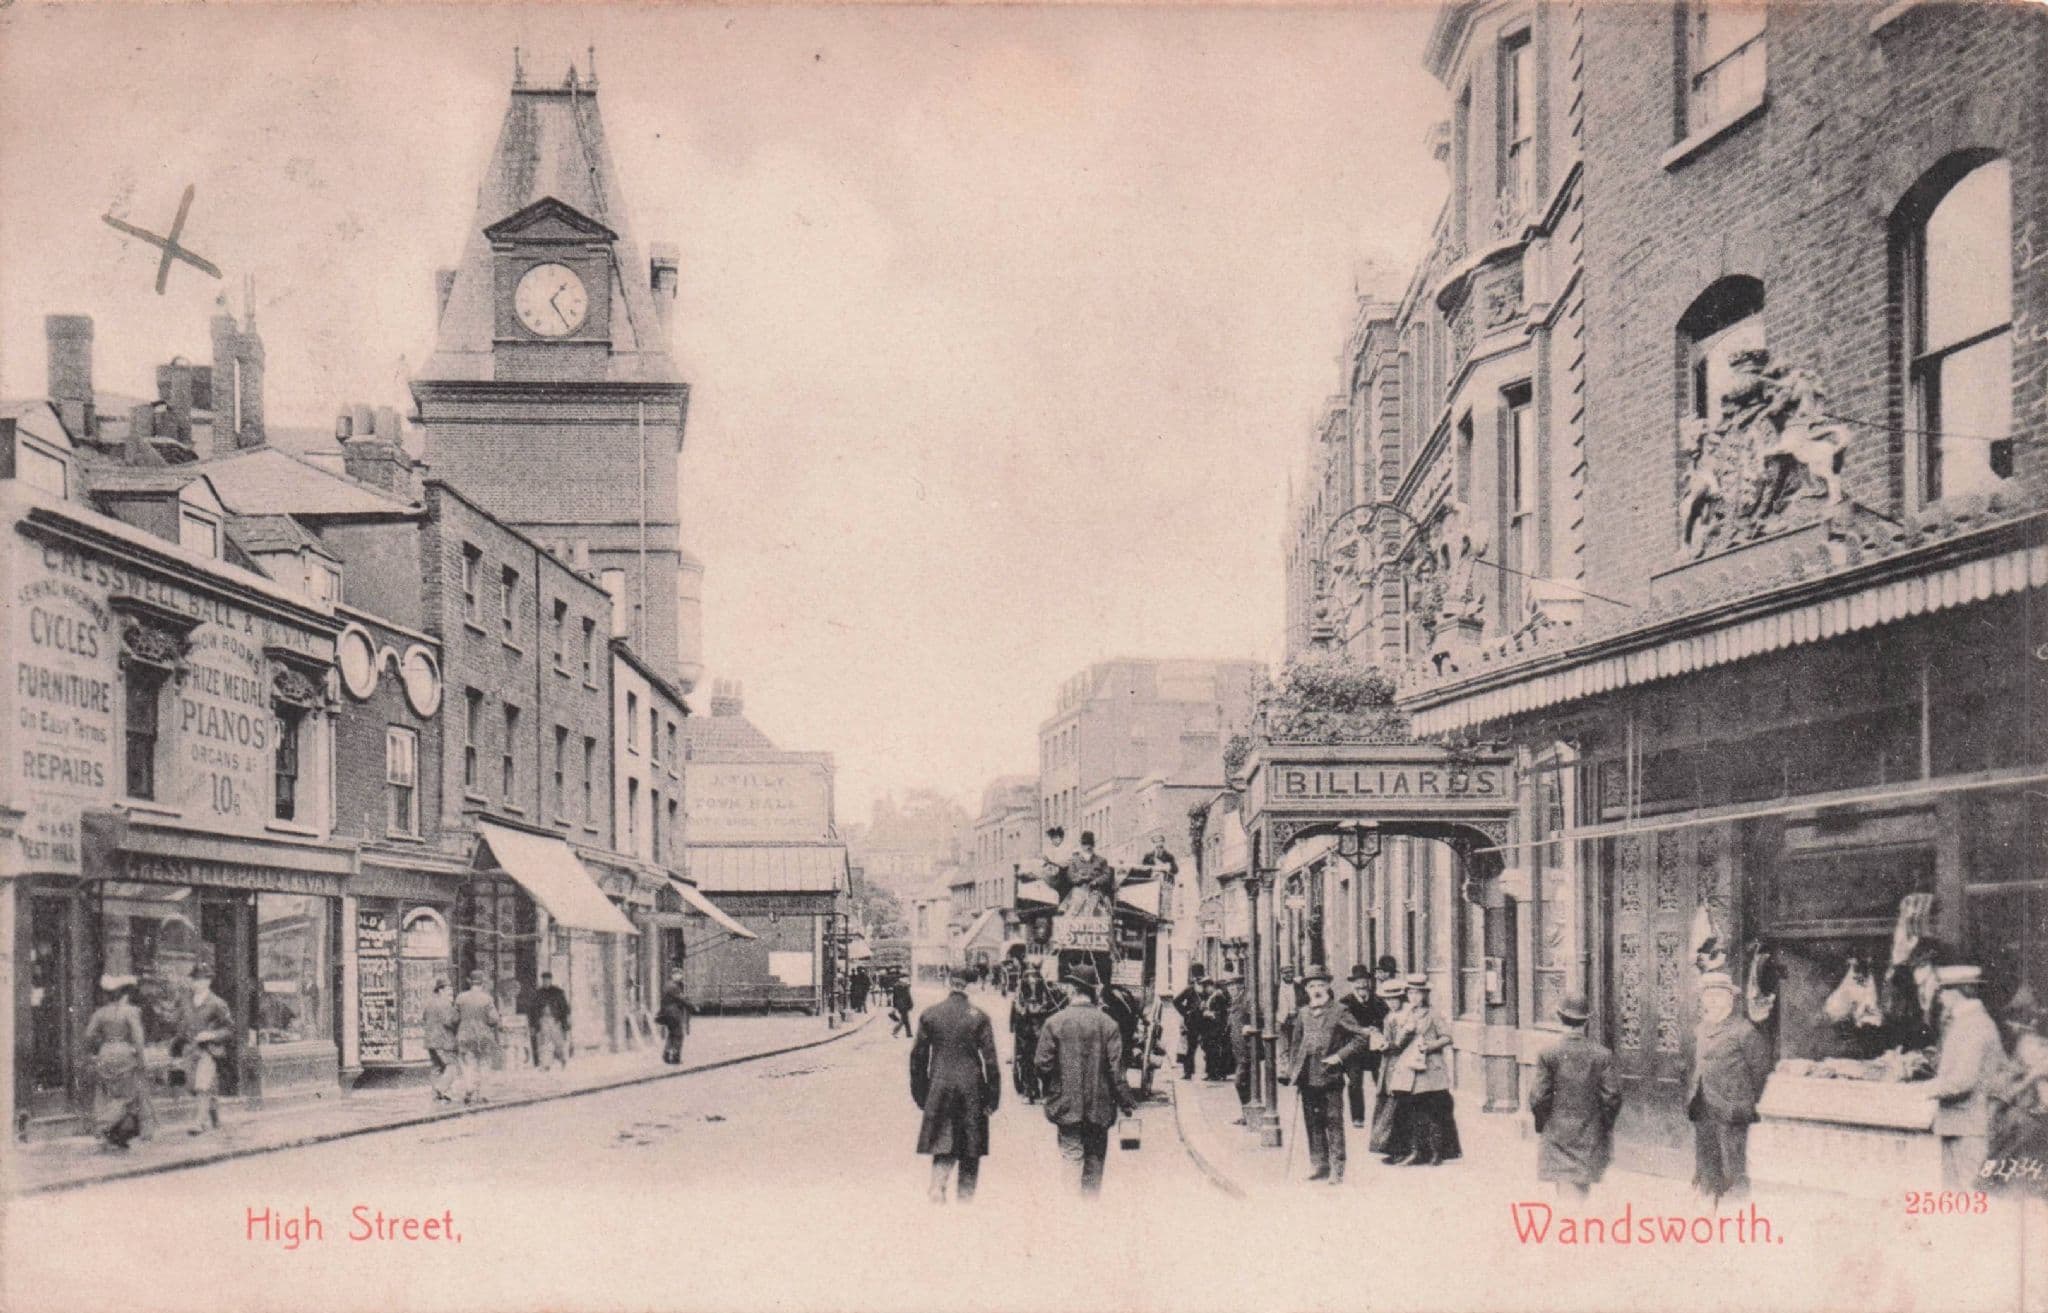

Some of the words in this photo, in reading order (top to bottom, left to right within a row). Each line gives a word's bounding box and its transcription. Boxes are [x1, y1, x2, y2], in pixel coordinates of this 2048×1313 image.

[30, 606, 99, 659] CYCLES
[18, 661, 110, 714] FURNITURE
[224, 671, 265, 709] MEDAL
[181, 698, 265, 750] PIANOS
[23, 749, 105, 788] REPAIRS
[192, 743, 240, 771] ORGANS
[1285, 770, 1496, 796] BILLIARDS
